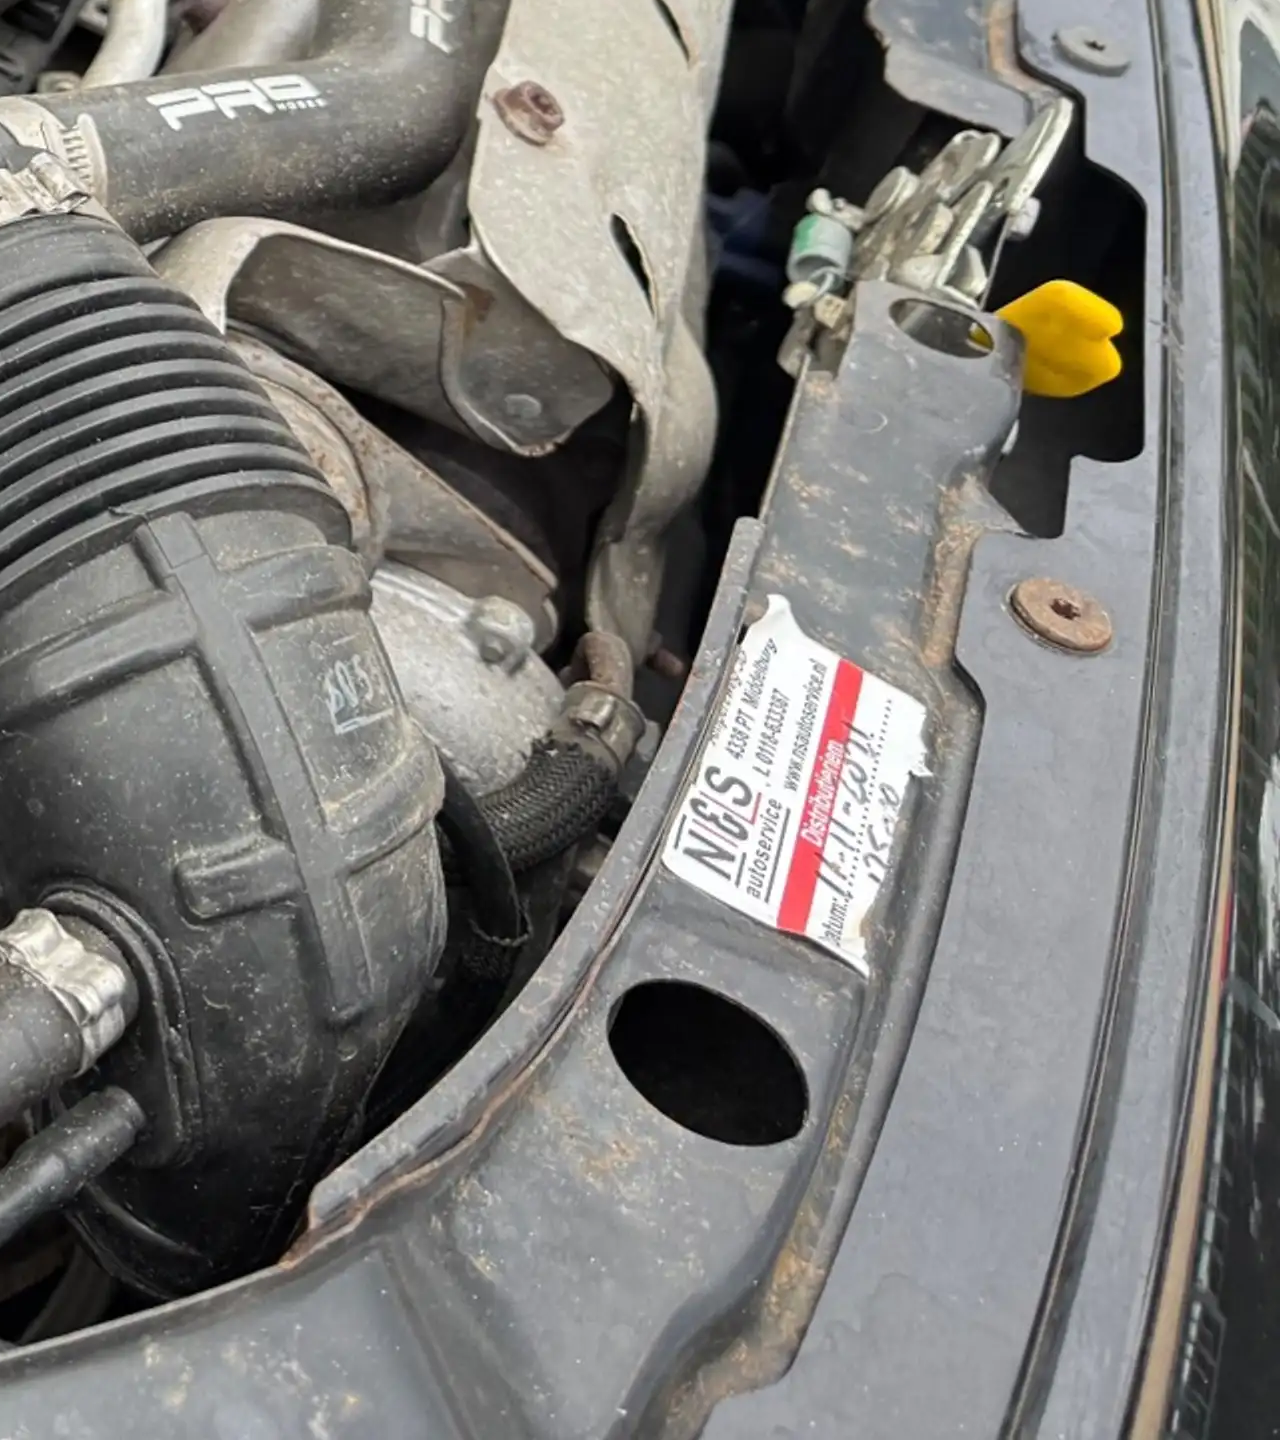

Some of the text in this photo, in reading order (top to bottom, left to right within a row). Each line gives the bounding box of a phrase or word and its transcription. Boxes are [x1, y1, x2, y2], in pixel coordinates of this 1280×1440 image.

[147, 74, 321, 131] PRO
[742, 636, 780, 709] Middelburg
[725, 727, 749, 761] 4338
[735, 707, 755, 732] PT
[782, 657, 830, 793] www.nsautoservice.nl
[799, 739, 844, 848] Distributieriem
[743, 796, 783, 900] autoservice
